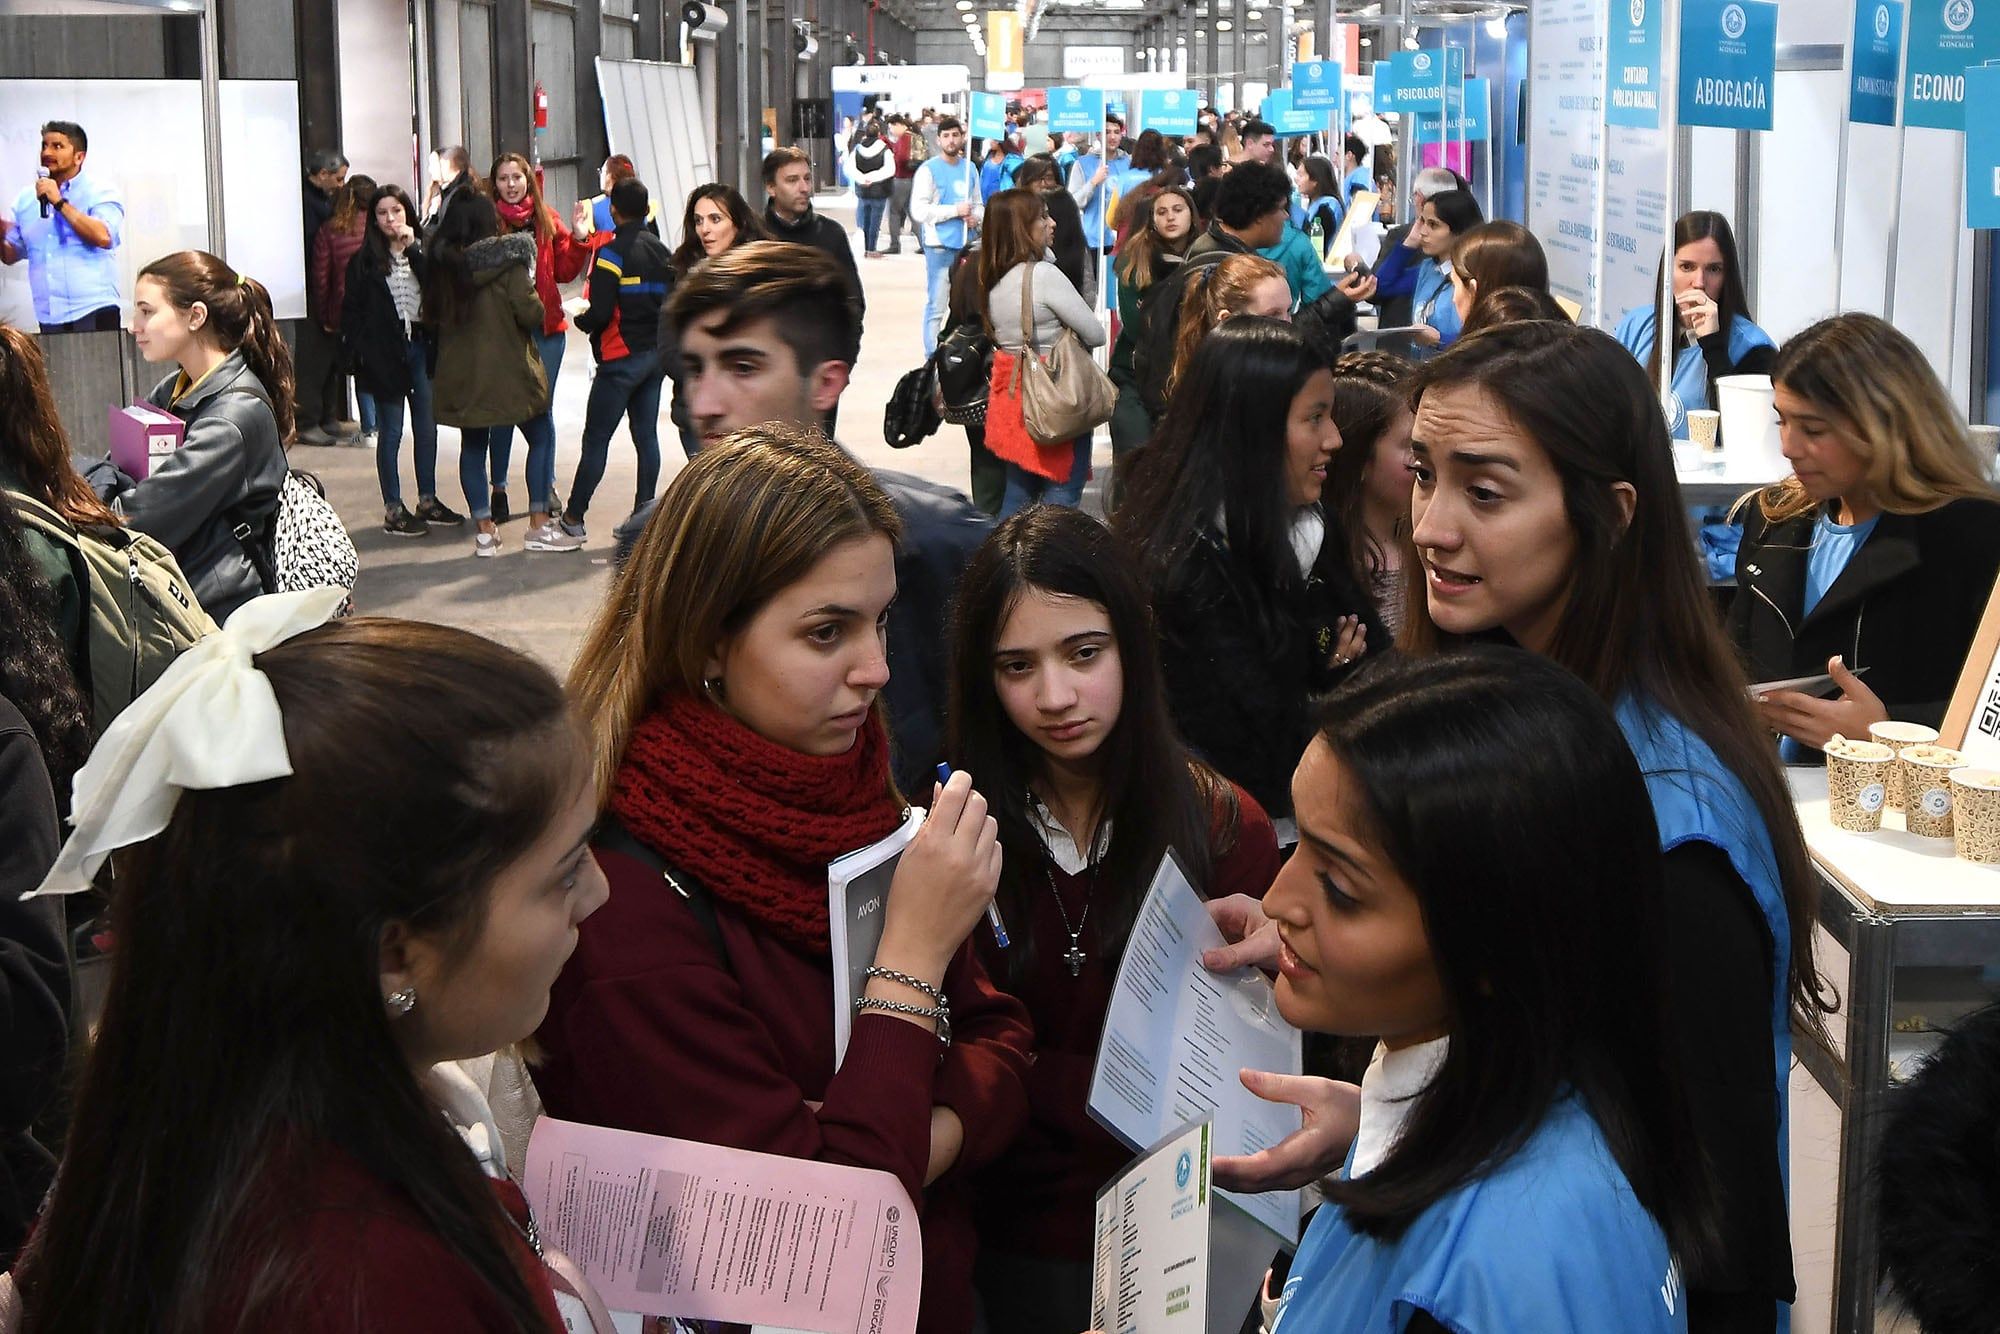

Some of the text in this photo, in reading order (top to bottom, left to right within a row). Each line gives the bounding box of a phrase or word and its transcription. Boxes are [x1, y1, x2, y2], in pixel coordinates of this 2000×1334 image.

[1624, 66, 1648, 85] CONTADOR
[1913, 73, 1965, 101] ECONO
[1634, 90, 1657, 110] NACIONAL
[1695, 76, 1766, 110] ABOGACÍA
[857, 895, 881, 921] AVON
[887, 1224, 899, 1268] UNCUYO
[879, 1299, 887, 1326] FACULTAD
